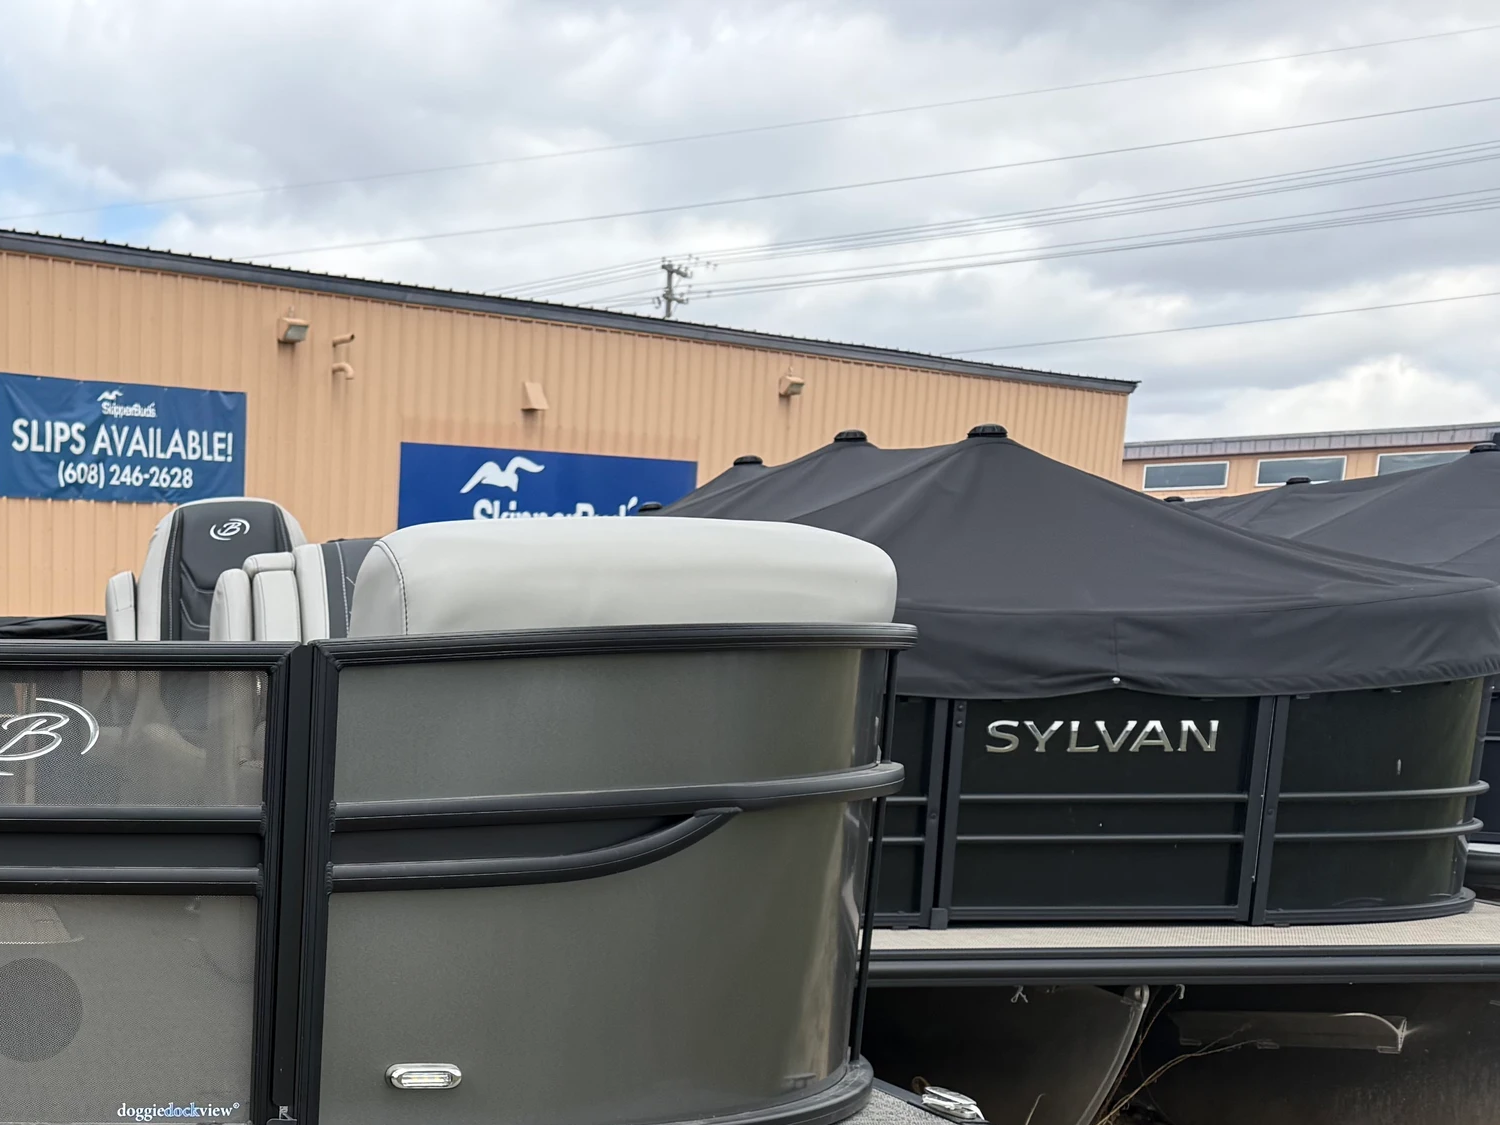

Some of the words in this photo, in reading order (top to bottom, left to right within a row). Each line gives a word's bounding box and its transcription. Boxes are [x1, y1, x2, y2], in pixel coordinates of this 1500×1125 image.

[11, 418, 86, 455] SLIPS
[92, 424, 233, 462] AVAILABLE!
[57, 460, 105, 488] (608)
[109, 464, 193, 488] 246-2628
[986, 720, 1219, 752] SYLVAN
